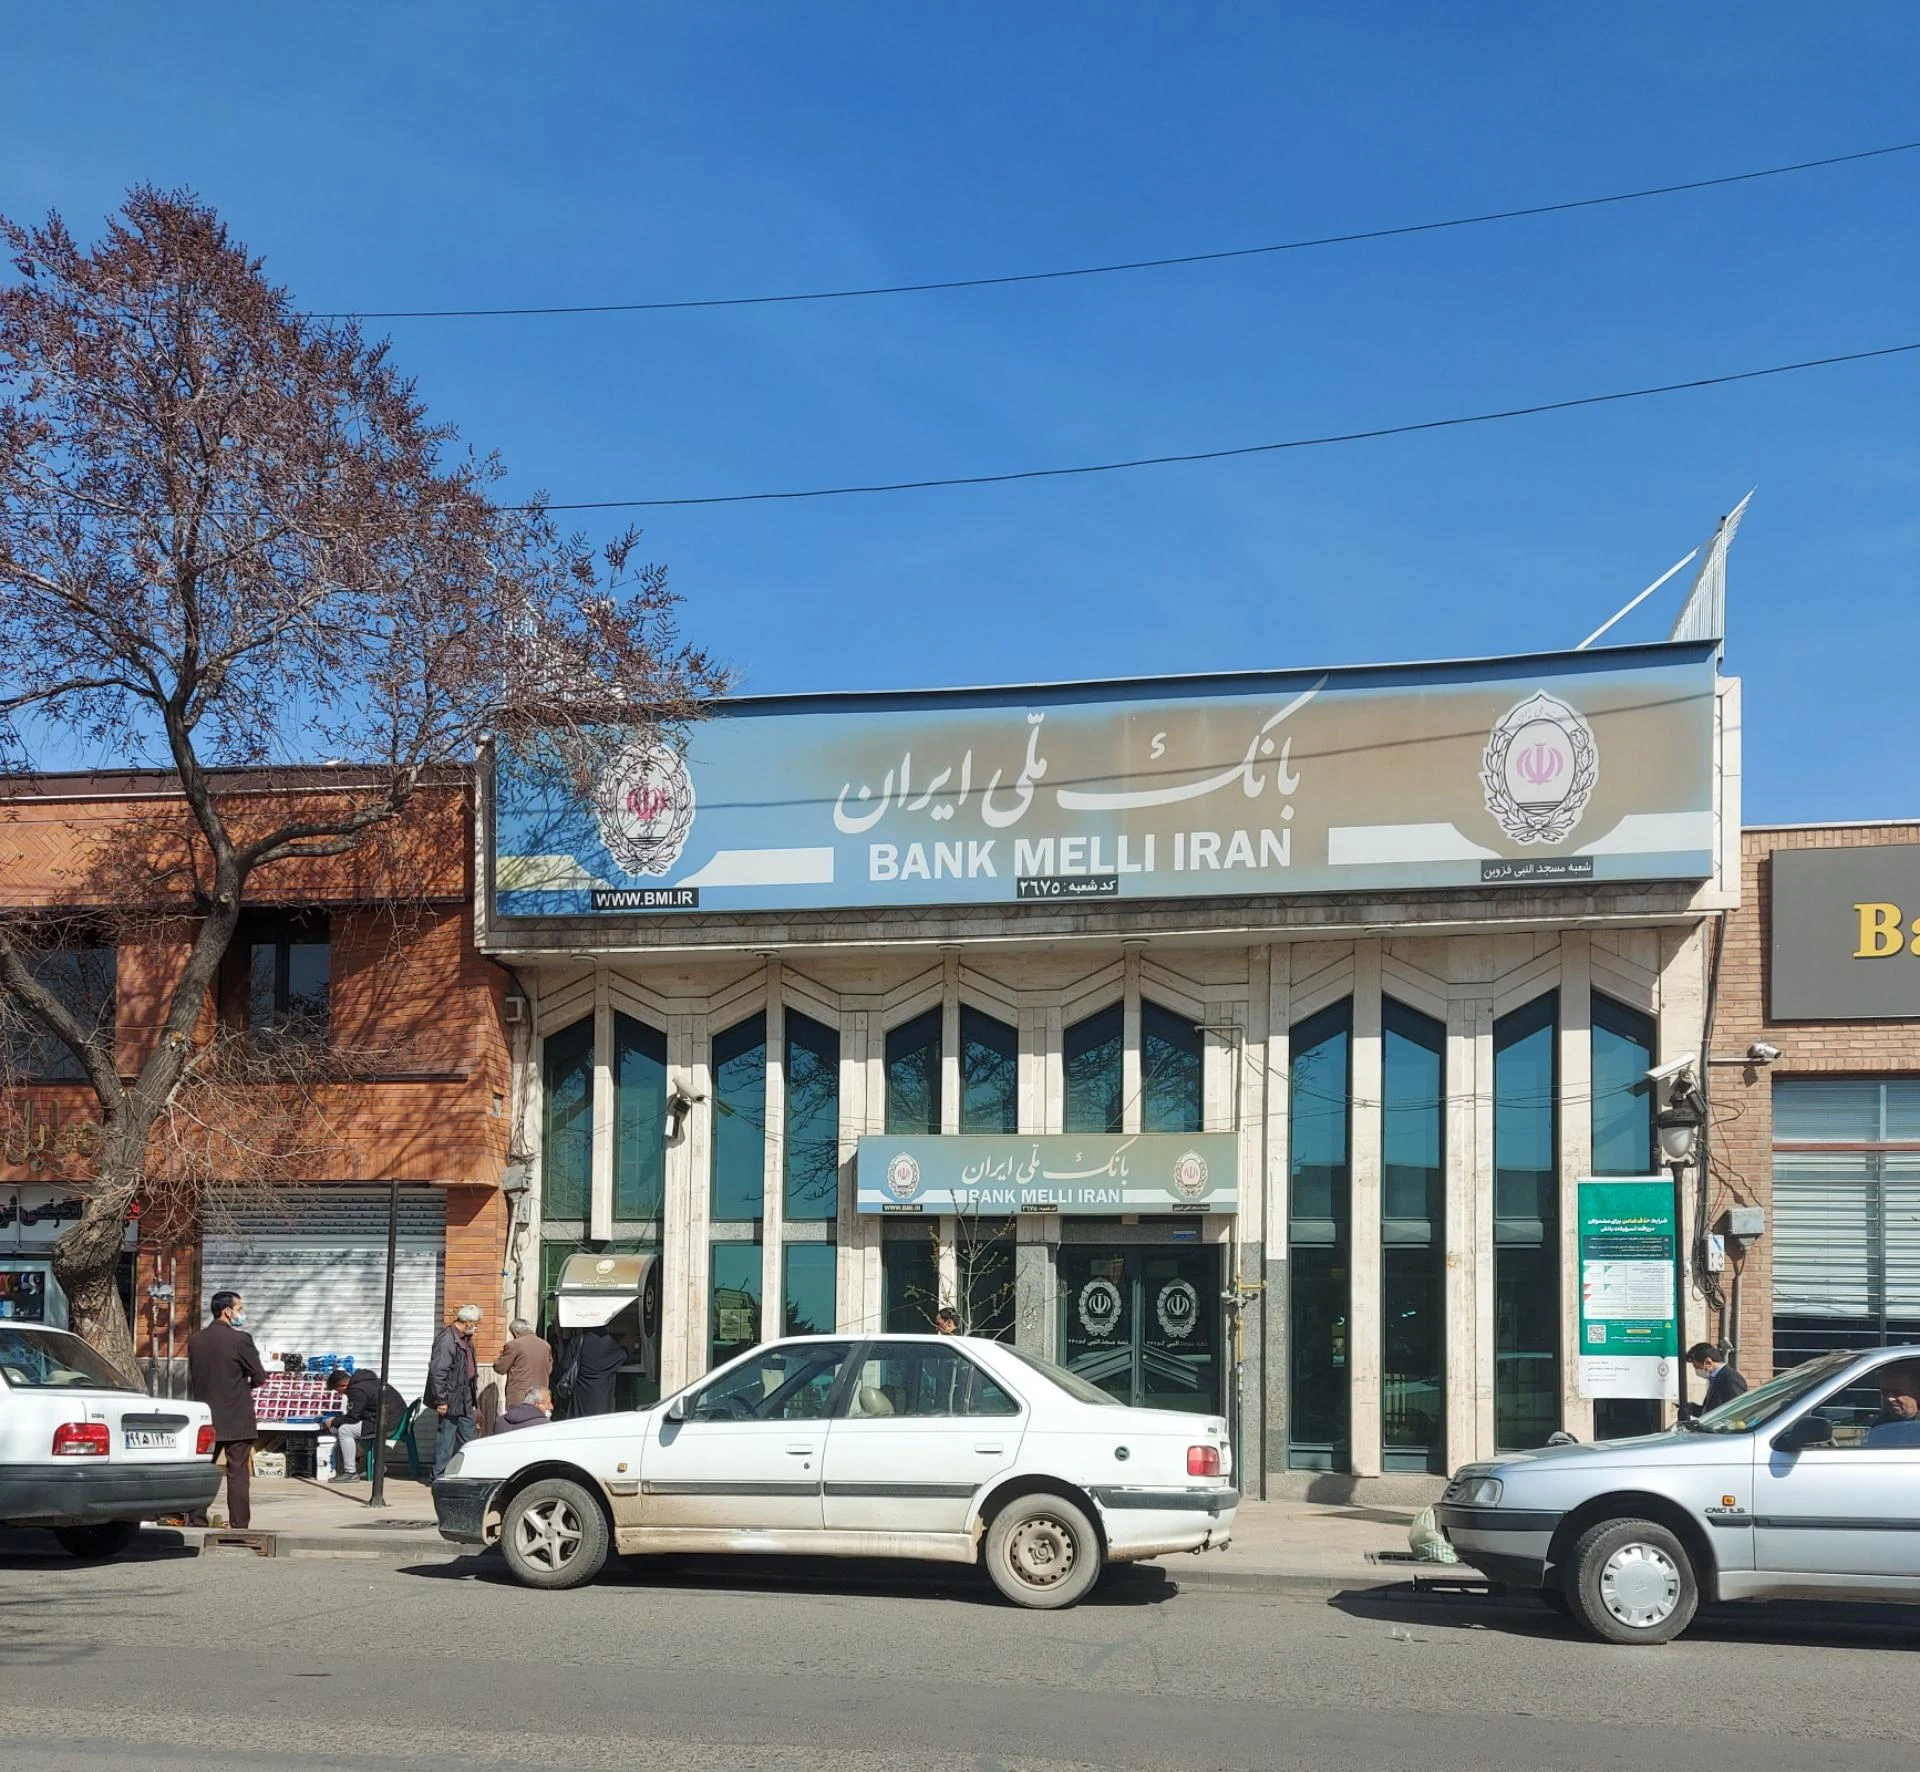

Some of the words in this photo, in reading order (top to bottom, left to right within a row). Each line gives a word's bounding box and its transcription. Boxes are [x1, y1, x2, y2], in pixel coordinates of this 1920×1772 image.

[833, 749, 972, 834] ایران
[869, 839, 998, 881] BANK
[1013, 834, 1156, 877] MELLI
[1174, 828, 1291, 871] IRAN
[1483, 864, 1512, 880] قزوین
[1536, 865, 1566, 876] مسجد
[1568, 861, 1591, 875] شعبه
[1099, 880, 1117, 891] کد
[596, 889, 694, 907] WWW.BMI.IR
[961, 1155, 1013, 1185] ایران
[968, 1189, 1016, 1204] BANK
[1021, 1189, 1072, 1203] MELLI
[1078, 1188, 1121, 1203] IRAN
